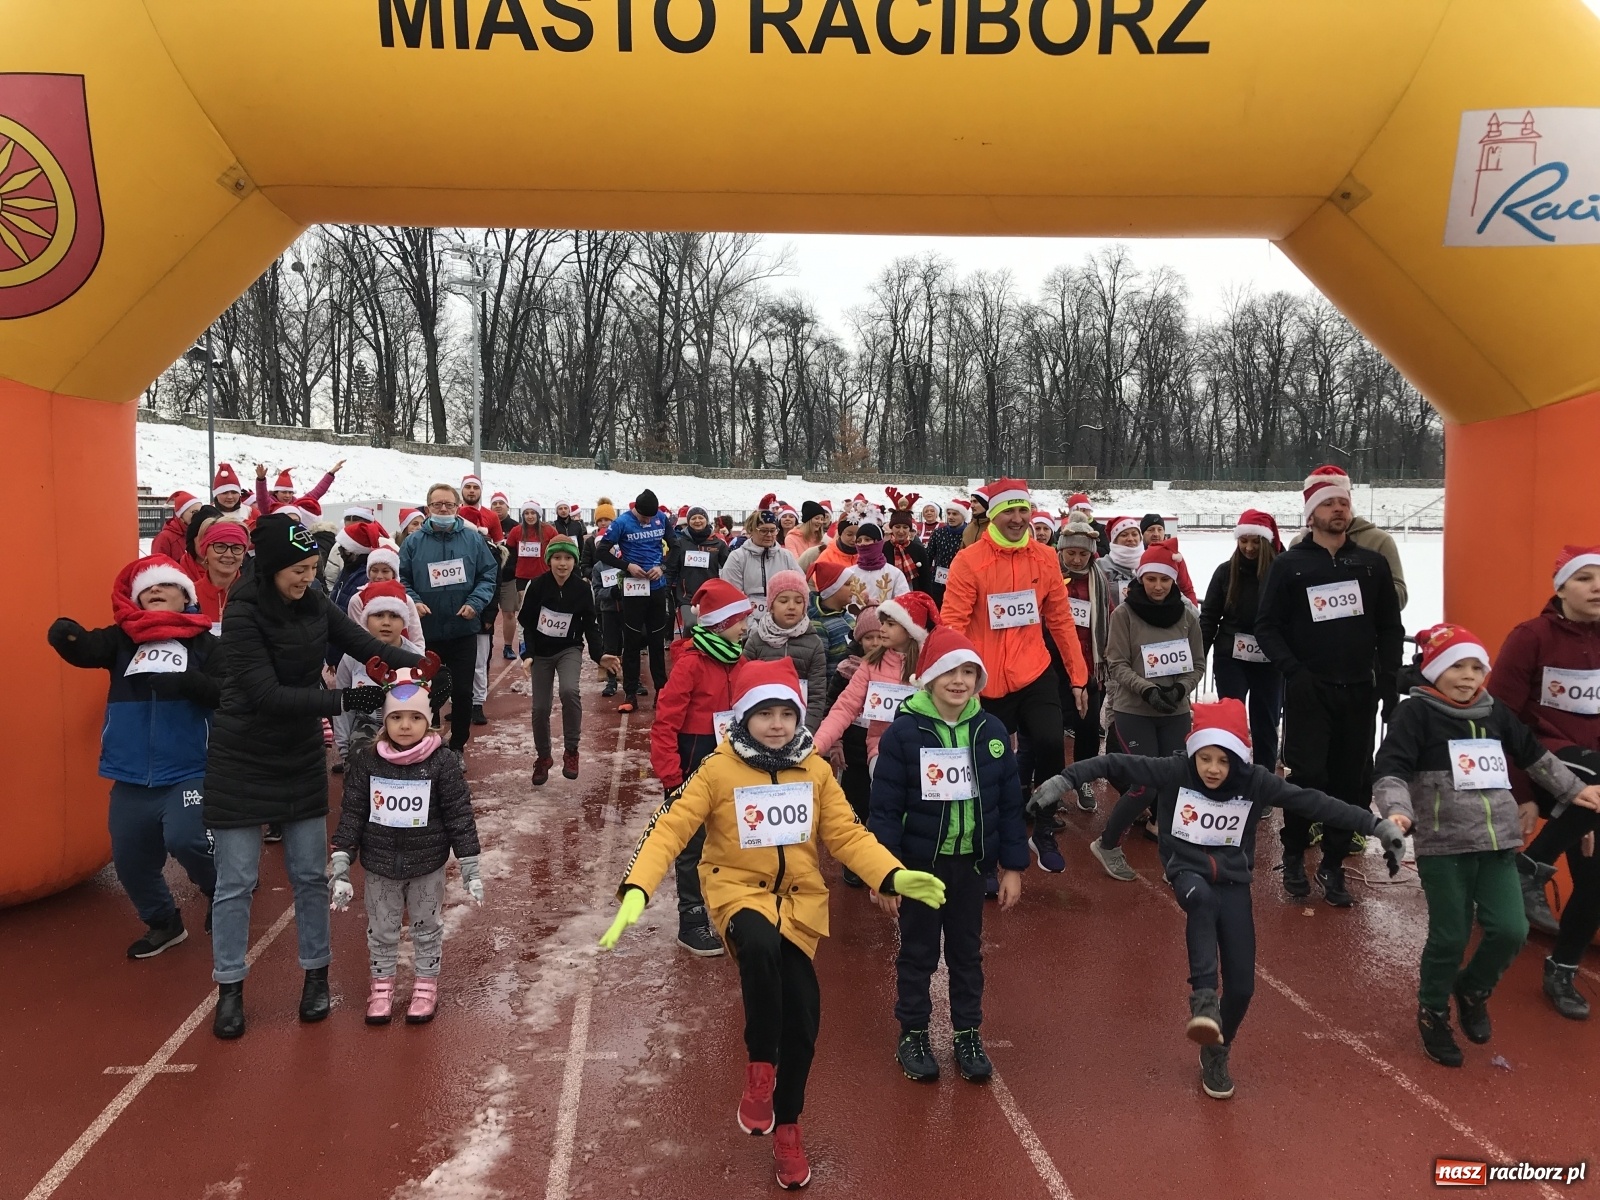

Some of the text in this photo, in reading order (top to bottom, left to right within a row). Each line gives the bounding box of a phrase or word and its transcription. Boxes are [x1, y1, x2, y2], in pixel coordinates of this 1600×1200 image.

[377, 0, 1210, 56] MIASTO RACIBORZ
[441, 566, 462, 578] 097
[632, 583, 646, 591] 174
[1327, 593, 1358, 608] 039
[1006, 602, 1034, 617] 052
[546, 618, 568, 630] 042
[1246, 644, 1262, 654] 02
[147, 648, 183, 667] 076
[1160, 650, 1187, 666] 005
[1477, 755, 1505, 772] 038
[946, 765, 972, 784] 016
[386, 795, 423, 812] 009
[766, 803, 808, 826] 008
[1199, 812, 1241, 831] 002
